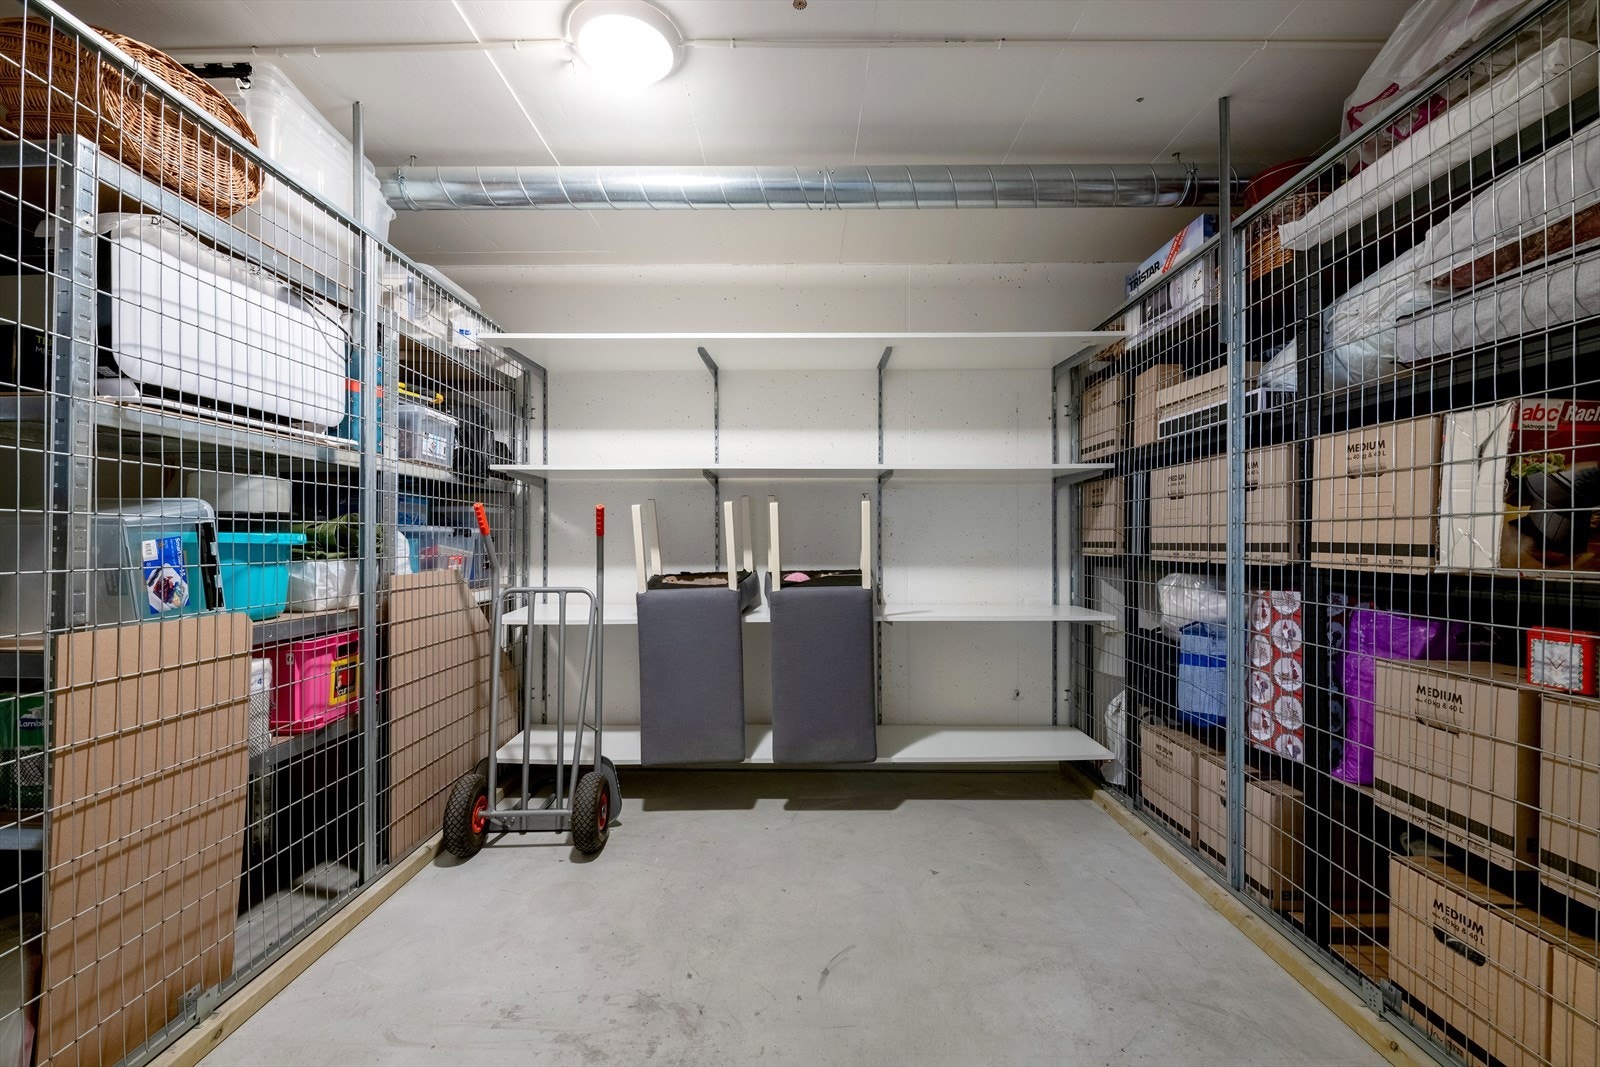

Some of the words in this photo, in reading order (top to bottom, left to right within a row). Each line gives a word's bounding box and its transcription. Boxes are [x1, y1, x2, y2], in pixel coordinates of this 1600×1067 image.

[1522, 404, 1559, 421] abc
[1347, 440, 1386, 453] MEDIUM
[1416, 684, 1463, 705] MEDIUM
[1433, 899, 1484, 936] MEDIUM
